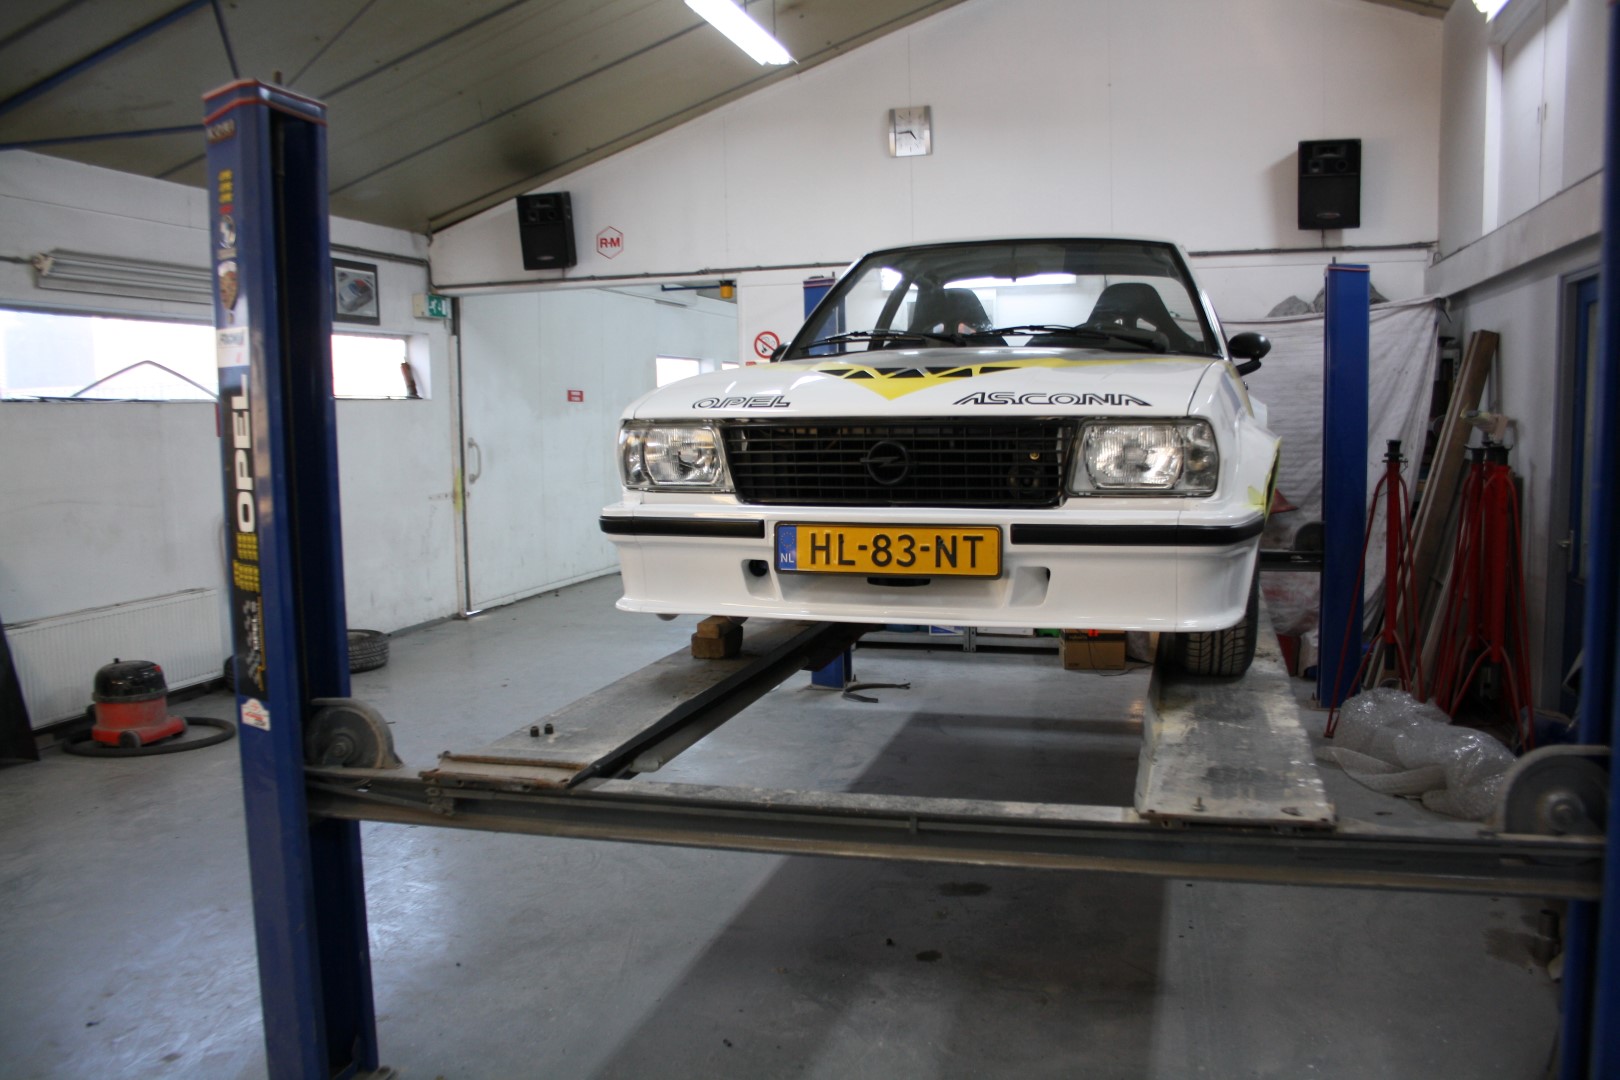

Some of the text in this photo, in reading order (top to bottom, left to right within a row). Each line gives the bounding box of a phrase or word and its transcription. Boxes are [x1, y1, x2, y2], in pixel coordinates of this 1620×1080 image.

[692, 391, 1153, 409] OPEL ASCONA
[231, 374, 256, 533] OPEL
[780, 552, 795, 563] NL
[810, 532, 984, 568] HL-83-NT
